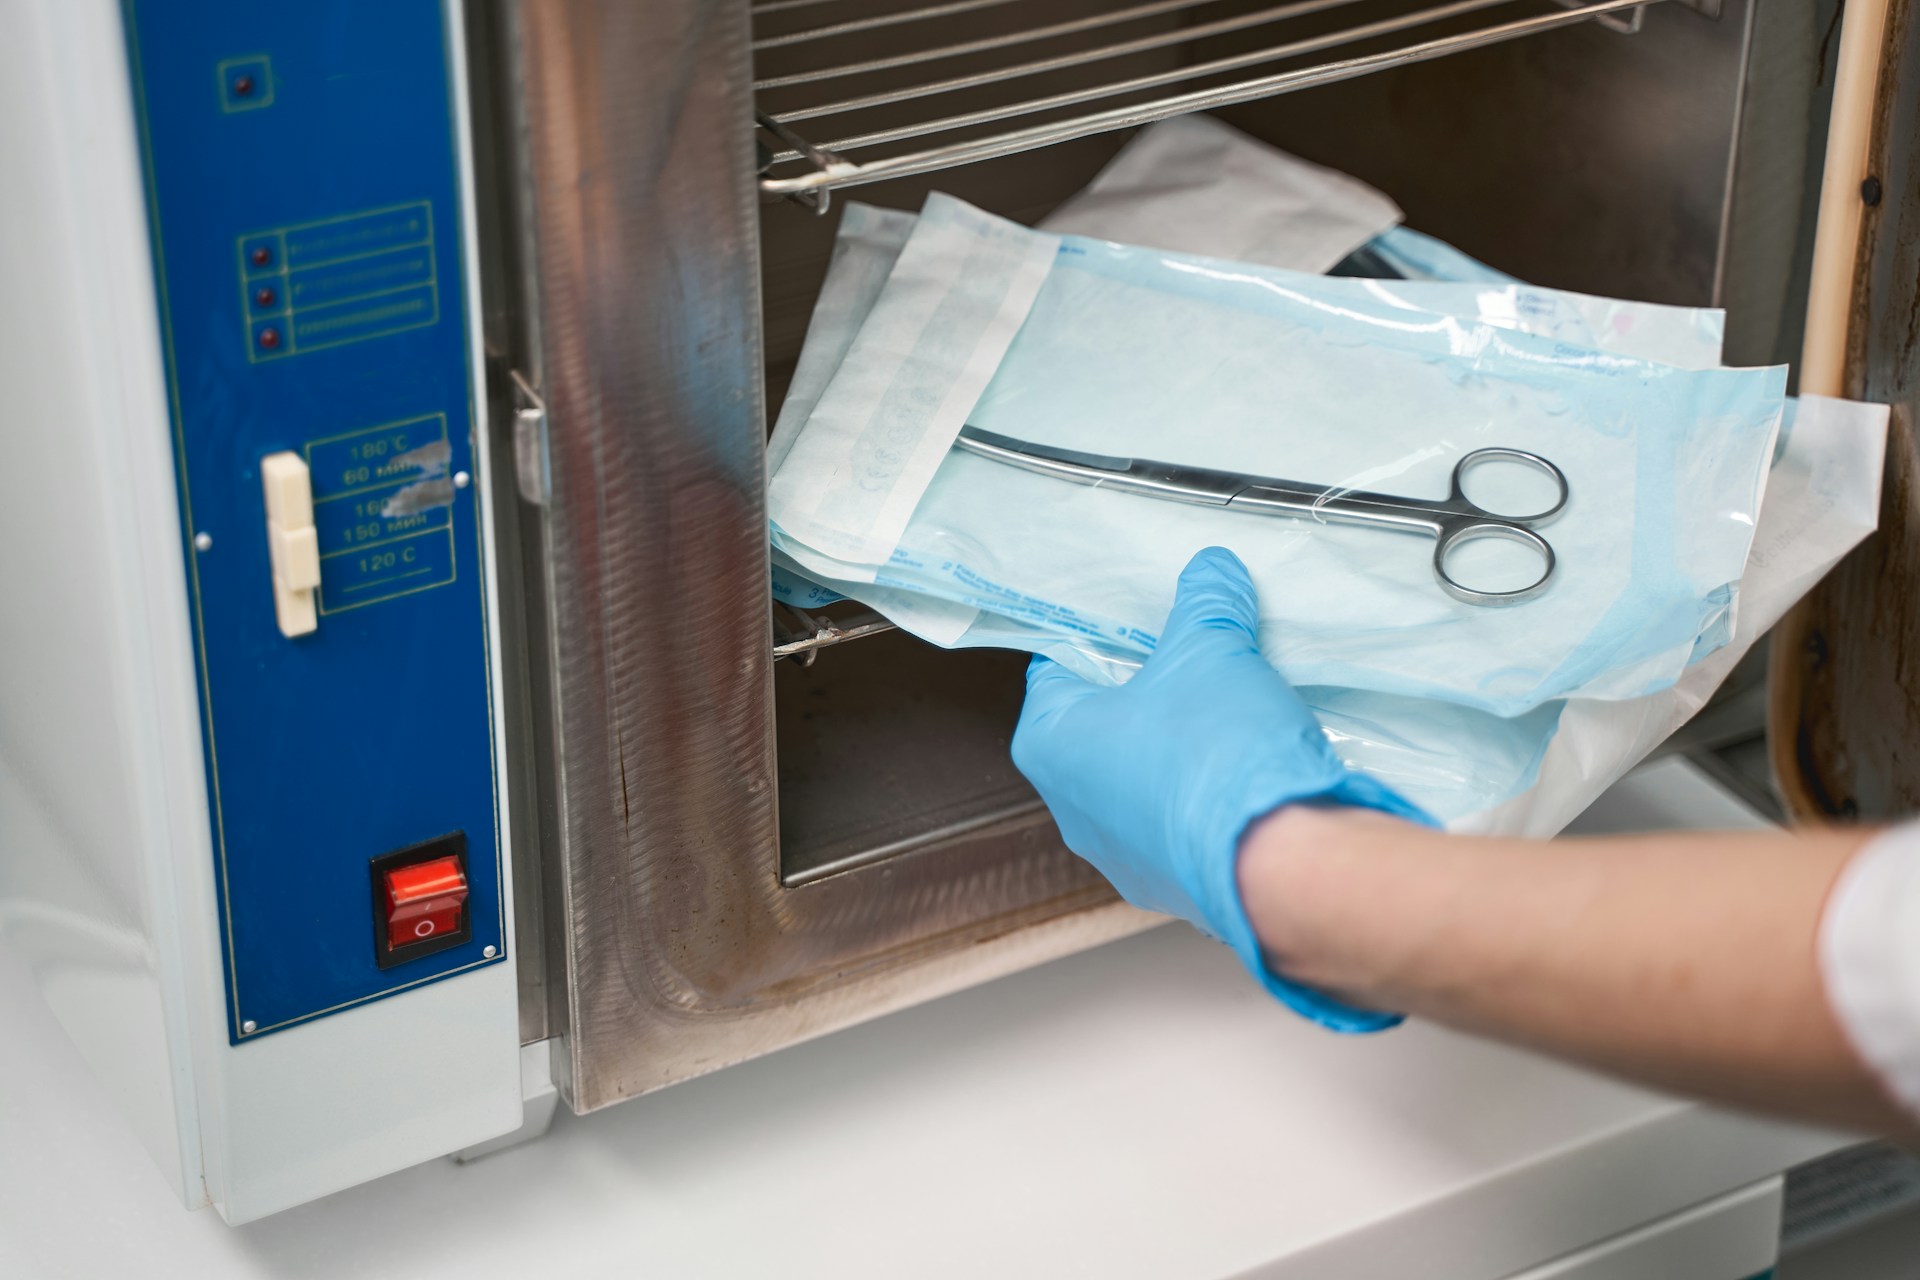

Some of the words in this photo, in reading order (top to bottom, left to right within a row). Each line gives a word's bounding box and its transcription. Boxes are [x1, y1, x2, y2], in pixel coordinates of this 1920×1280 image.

[344, 467, 370, 485] 60
[345, 522, 380, 543] 150
[808, 586, 820, 599] 3
